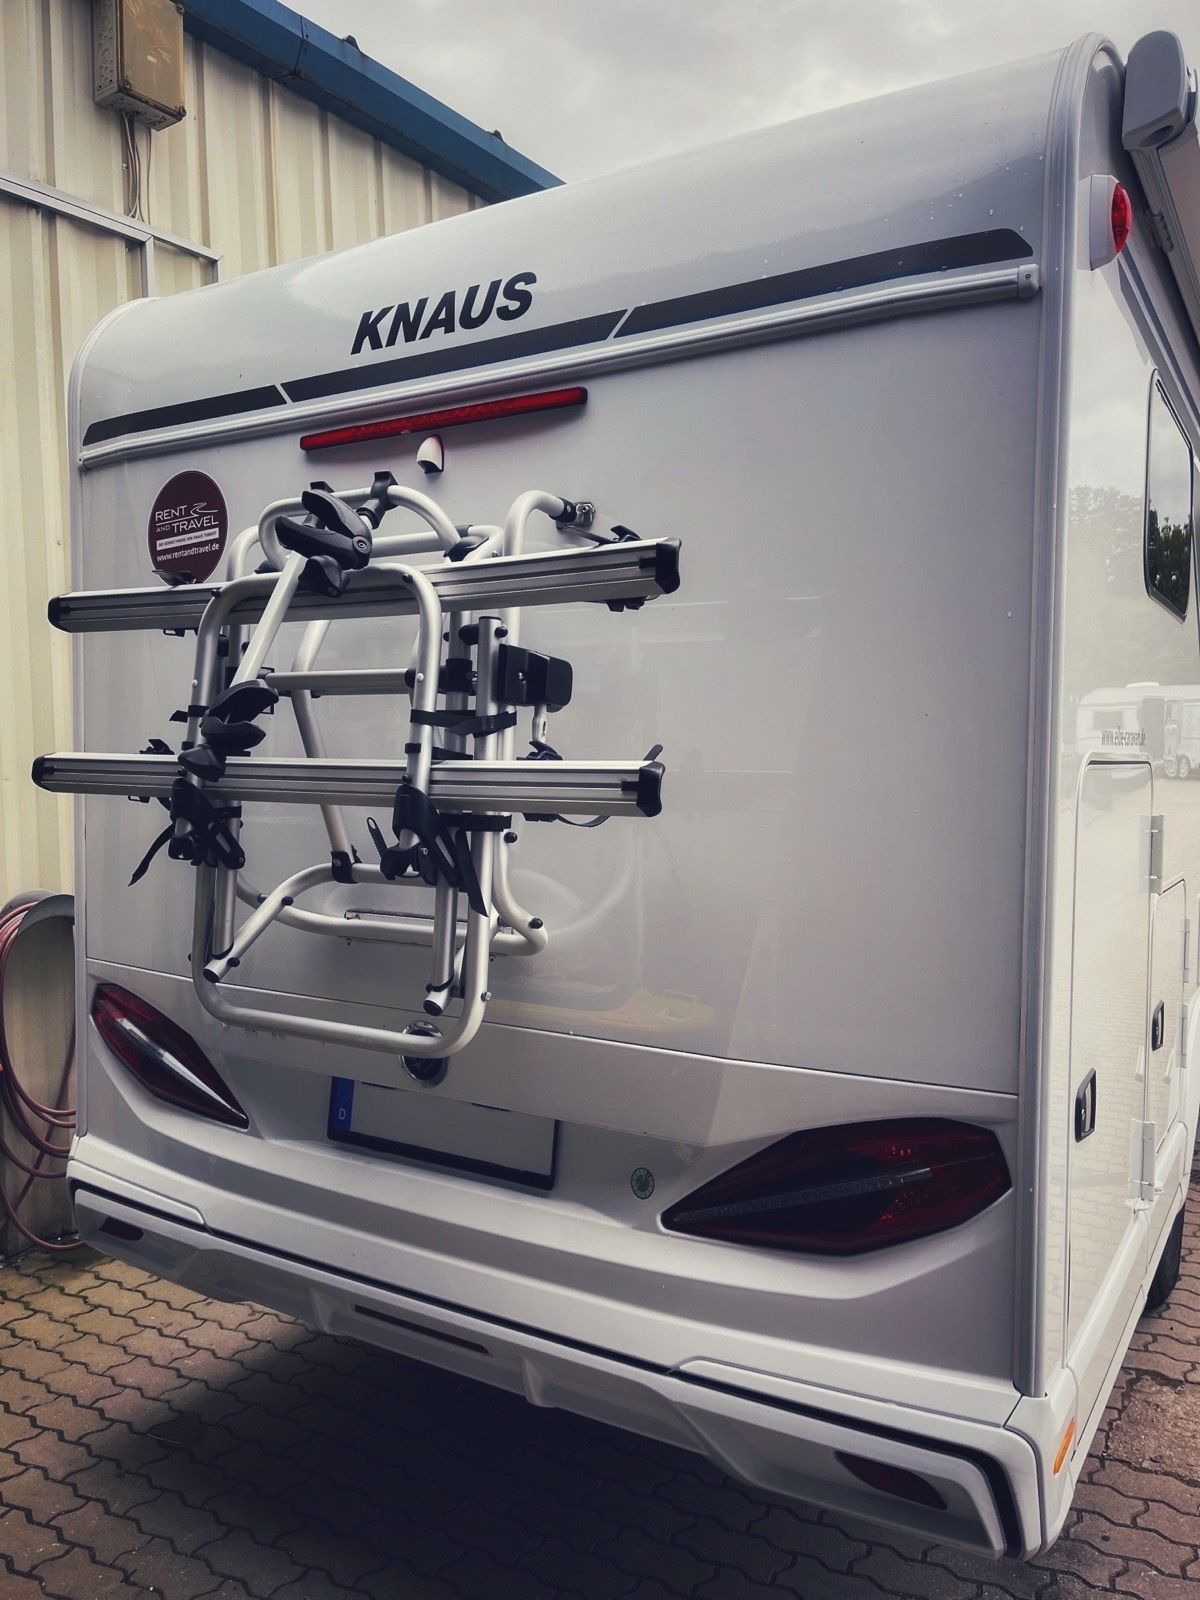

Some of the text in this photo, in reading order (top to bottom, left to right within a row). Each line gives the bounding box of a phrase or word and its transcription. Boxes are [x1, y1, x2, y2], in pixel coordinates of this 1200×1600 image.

[350, 271, 537, 355] KNAUS
[155, 505, 187, 521] RENT
[156, 515, 219, 533] AND TRAVEL
[157, 543, 220, 562] www.rentandtravel.de
[339, 1108, 346, 1120] D
